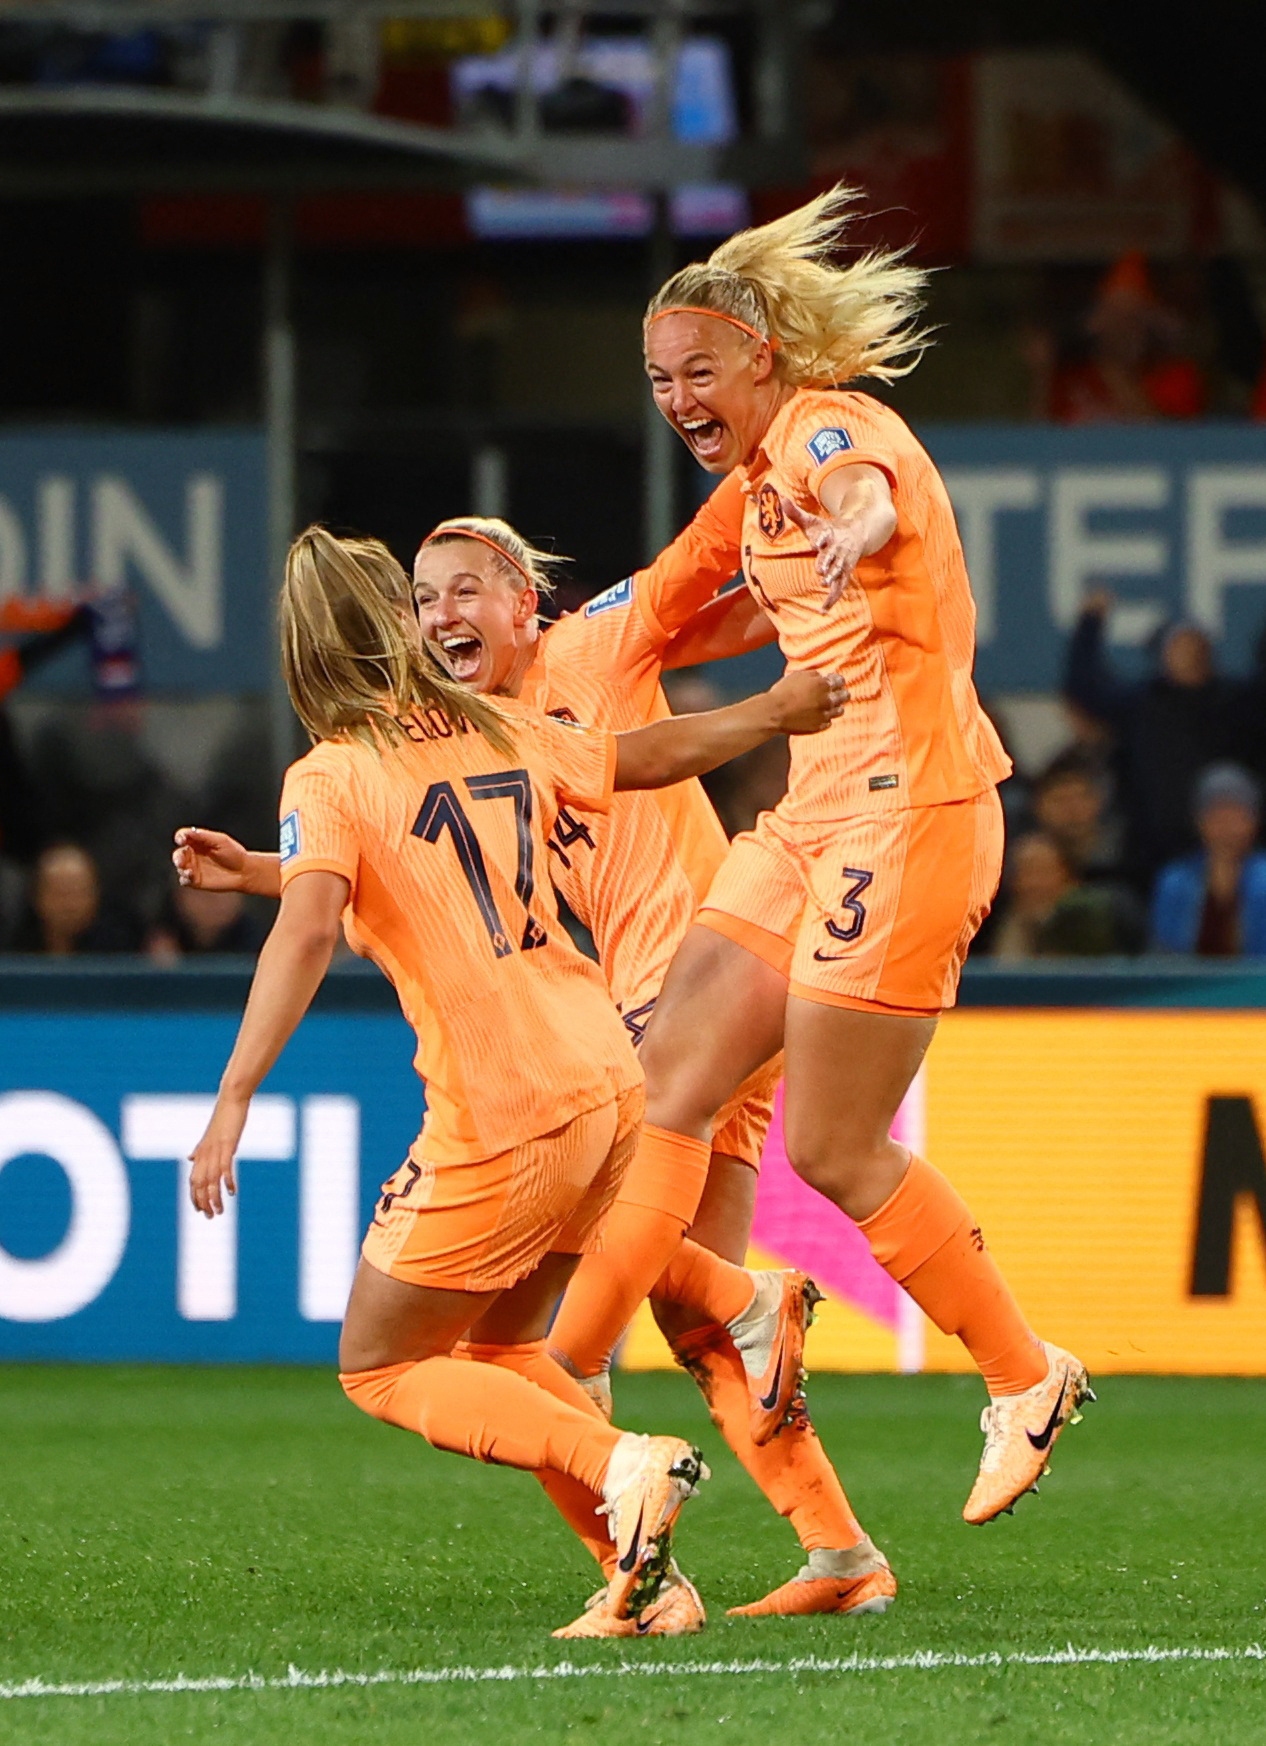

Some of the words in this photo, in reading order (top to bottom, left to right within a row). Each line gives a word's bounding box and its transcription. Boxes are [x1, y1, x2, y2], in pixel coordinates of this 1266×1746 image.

[0, 472, 224, 648] IN
[411, 769, 548, 958] 17
[824, 867, 873, 942] 3
[0, 1089, 361, 1322] OTI
